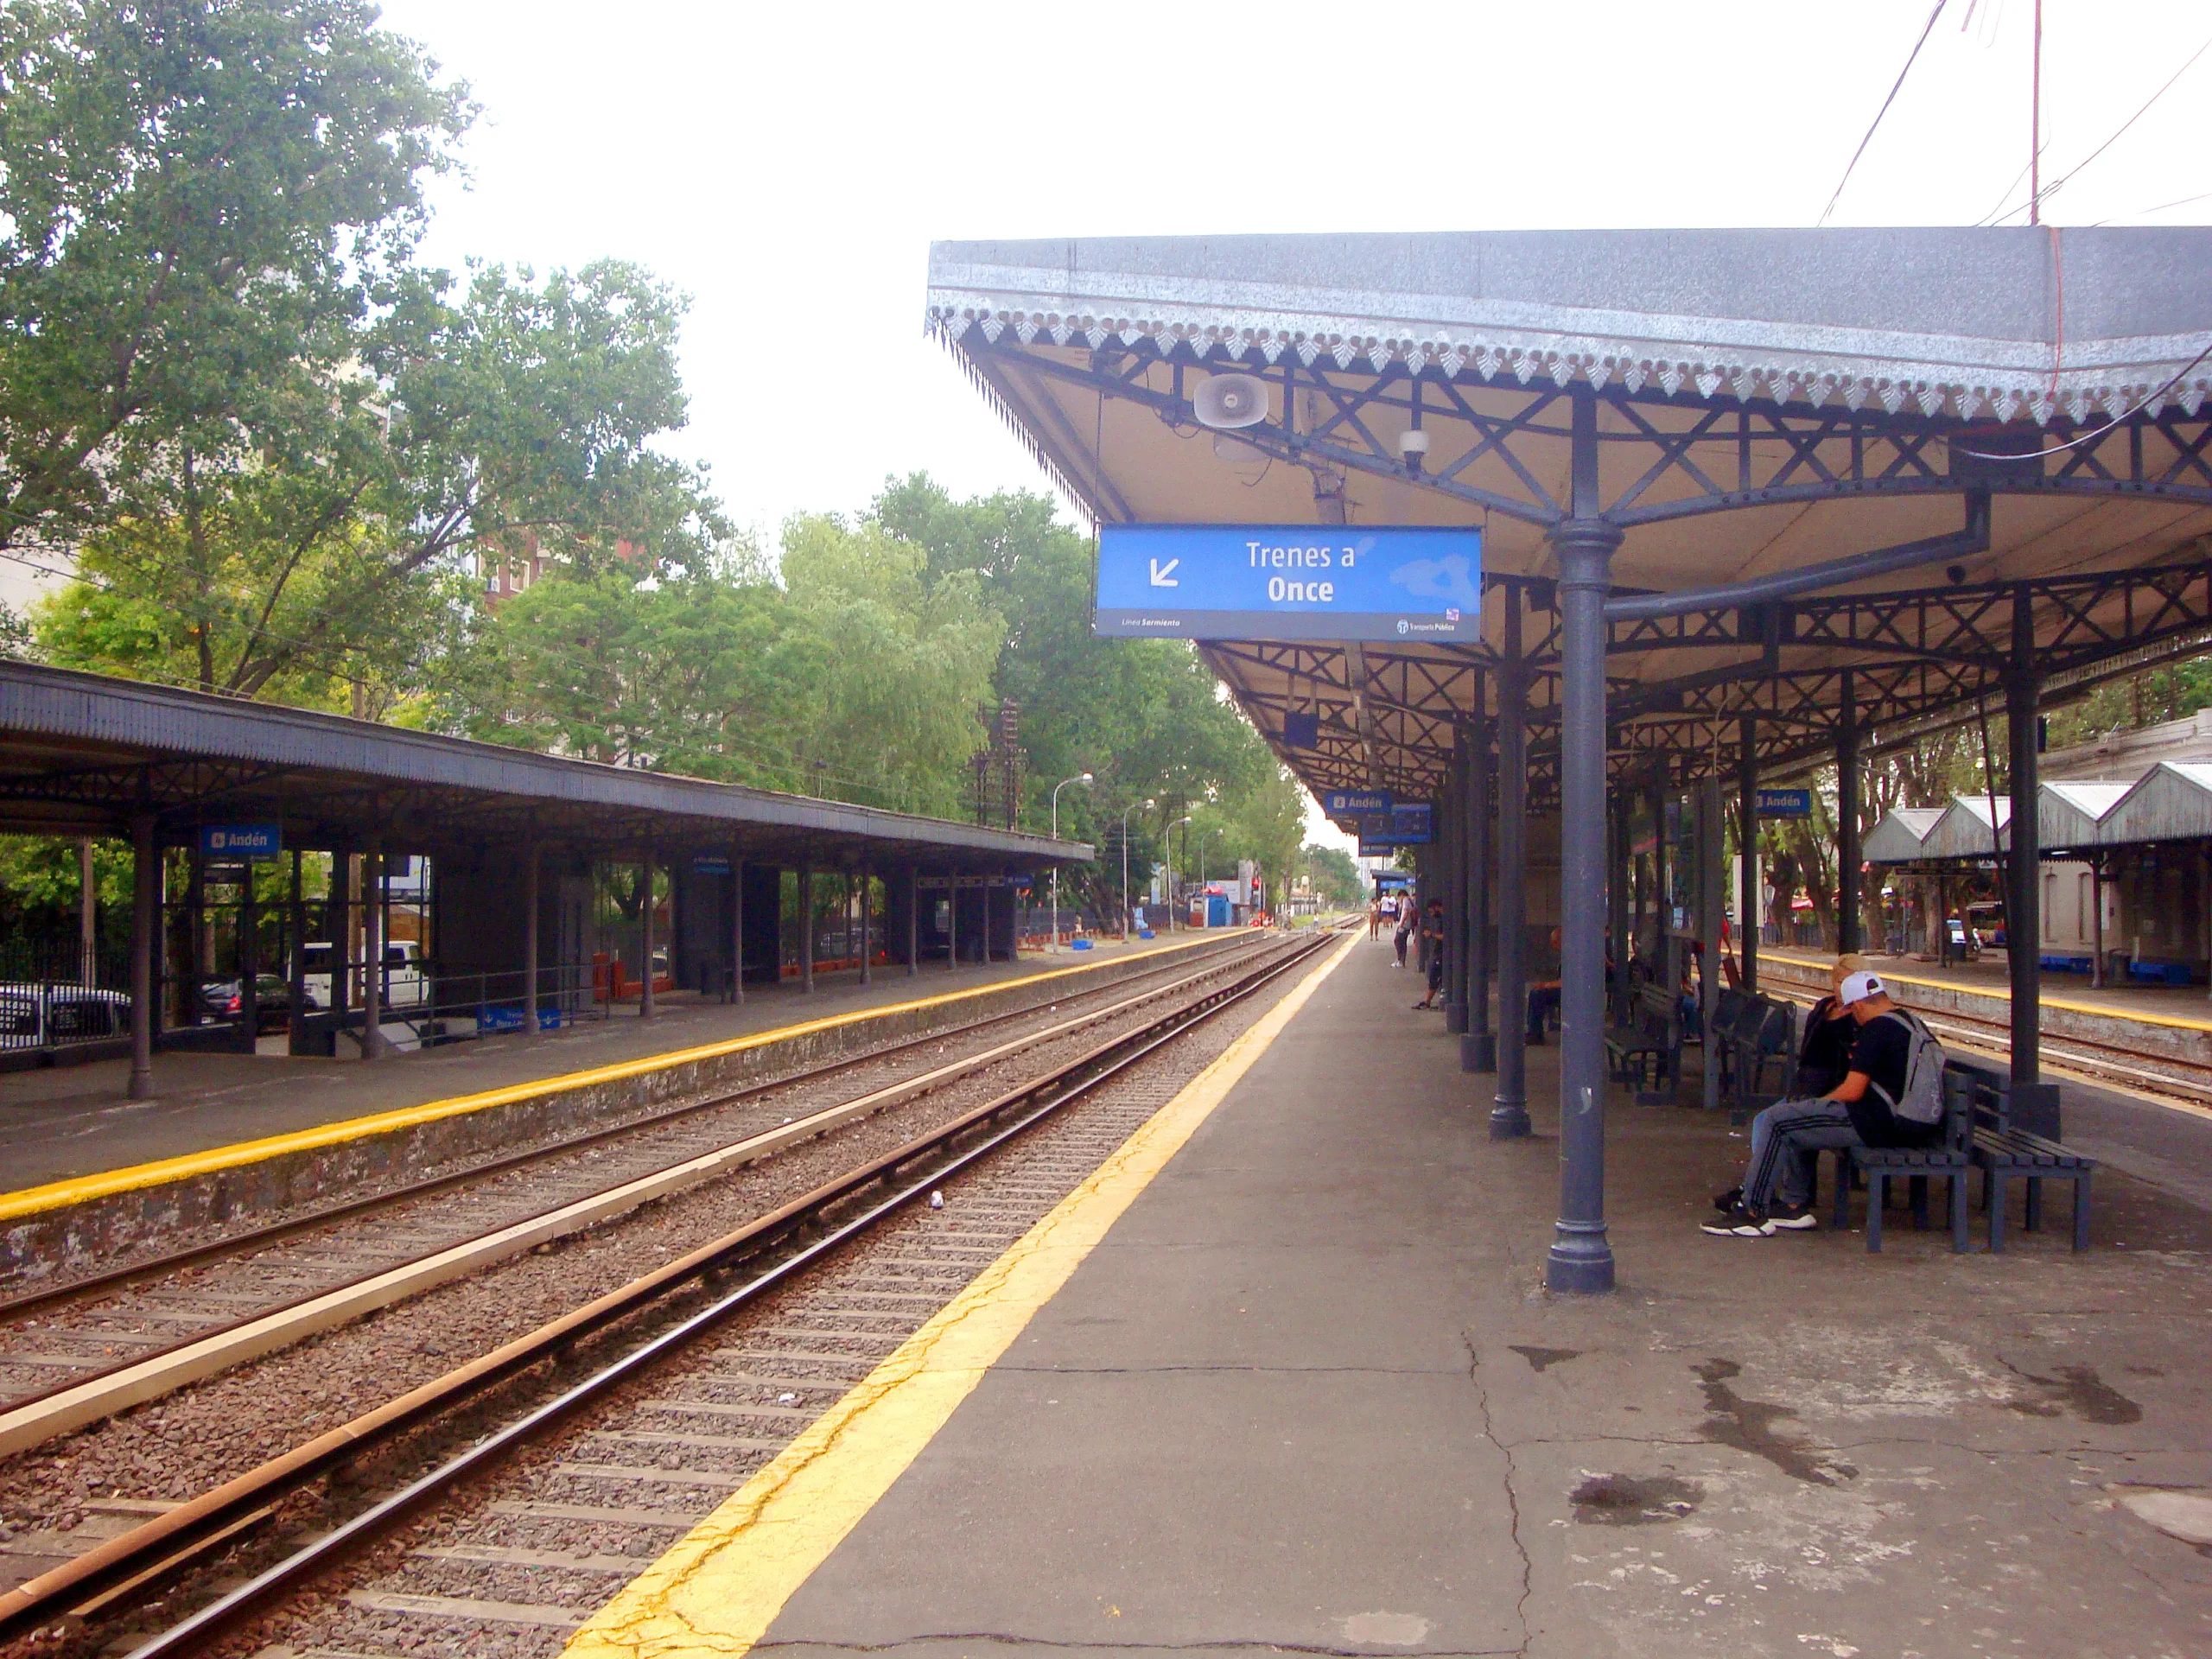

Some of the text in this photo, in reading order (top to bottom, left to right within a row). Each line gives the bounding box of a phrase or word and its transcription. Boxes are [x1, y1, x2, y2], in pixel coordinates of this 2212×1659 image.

[1246, 542, 1355, 568] Trenes a
[1268, 576, 1334, 602] Once
[1141, 619, 1180, 627] Sarmiento
[1434, 622, 1455, 632] Público
[1348, 796, 1382, 809] Andén
[1767, 795, 1800, 807] Andén
[228, 831, 267, 846] Andén
